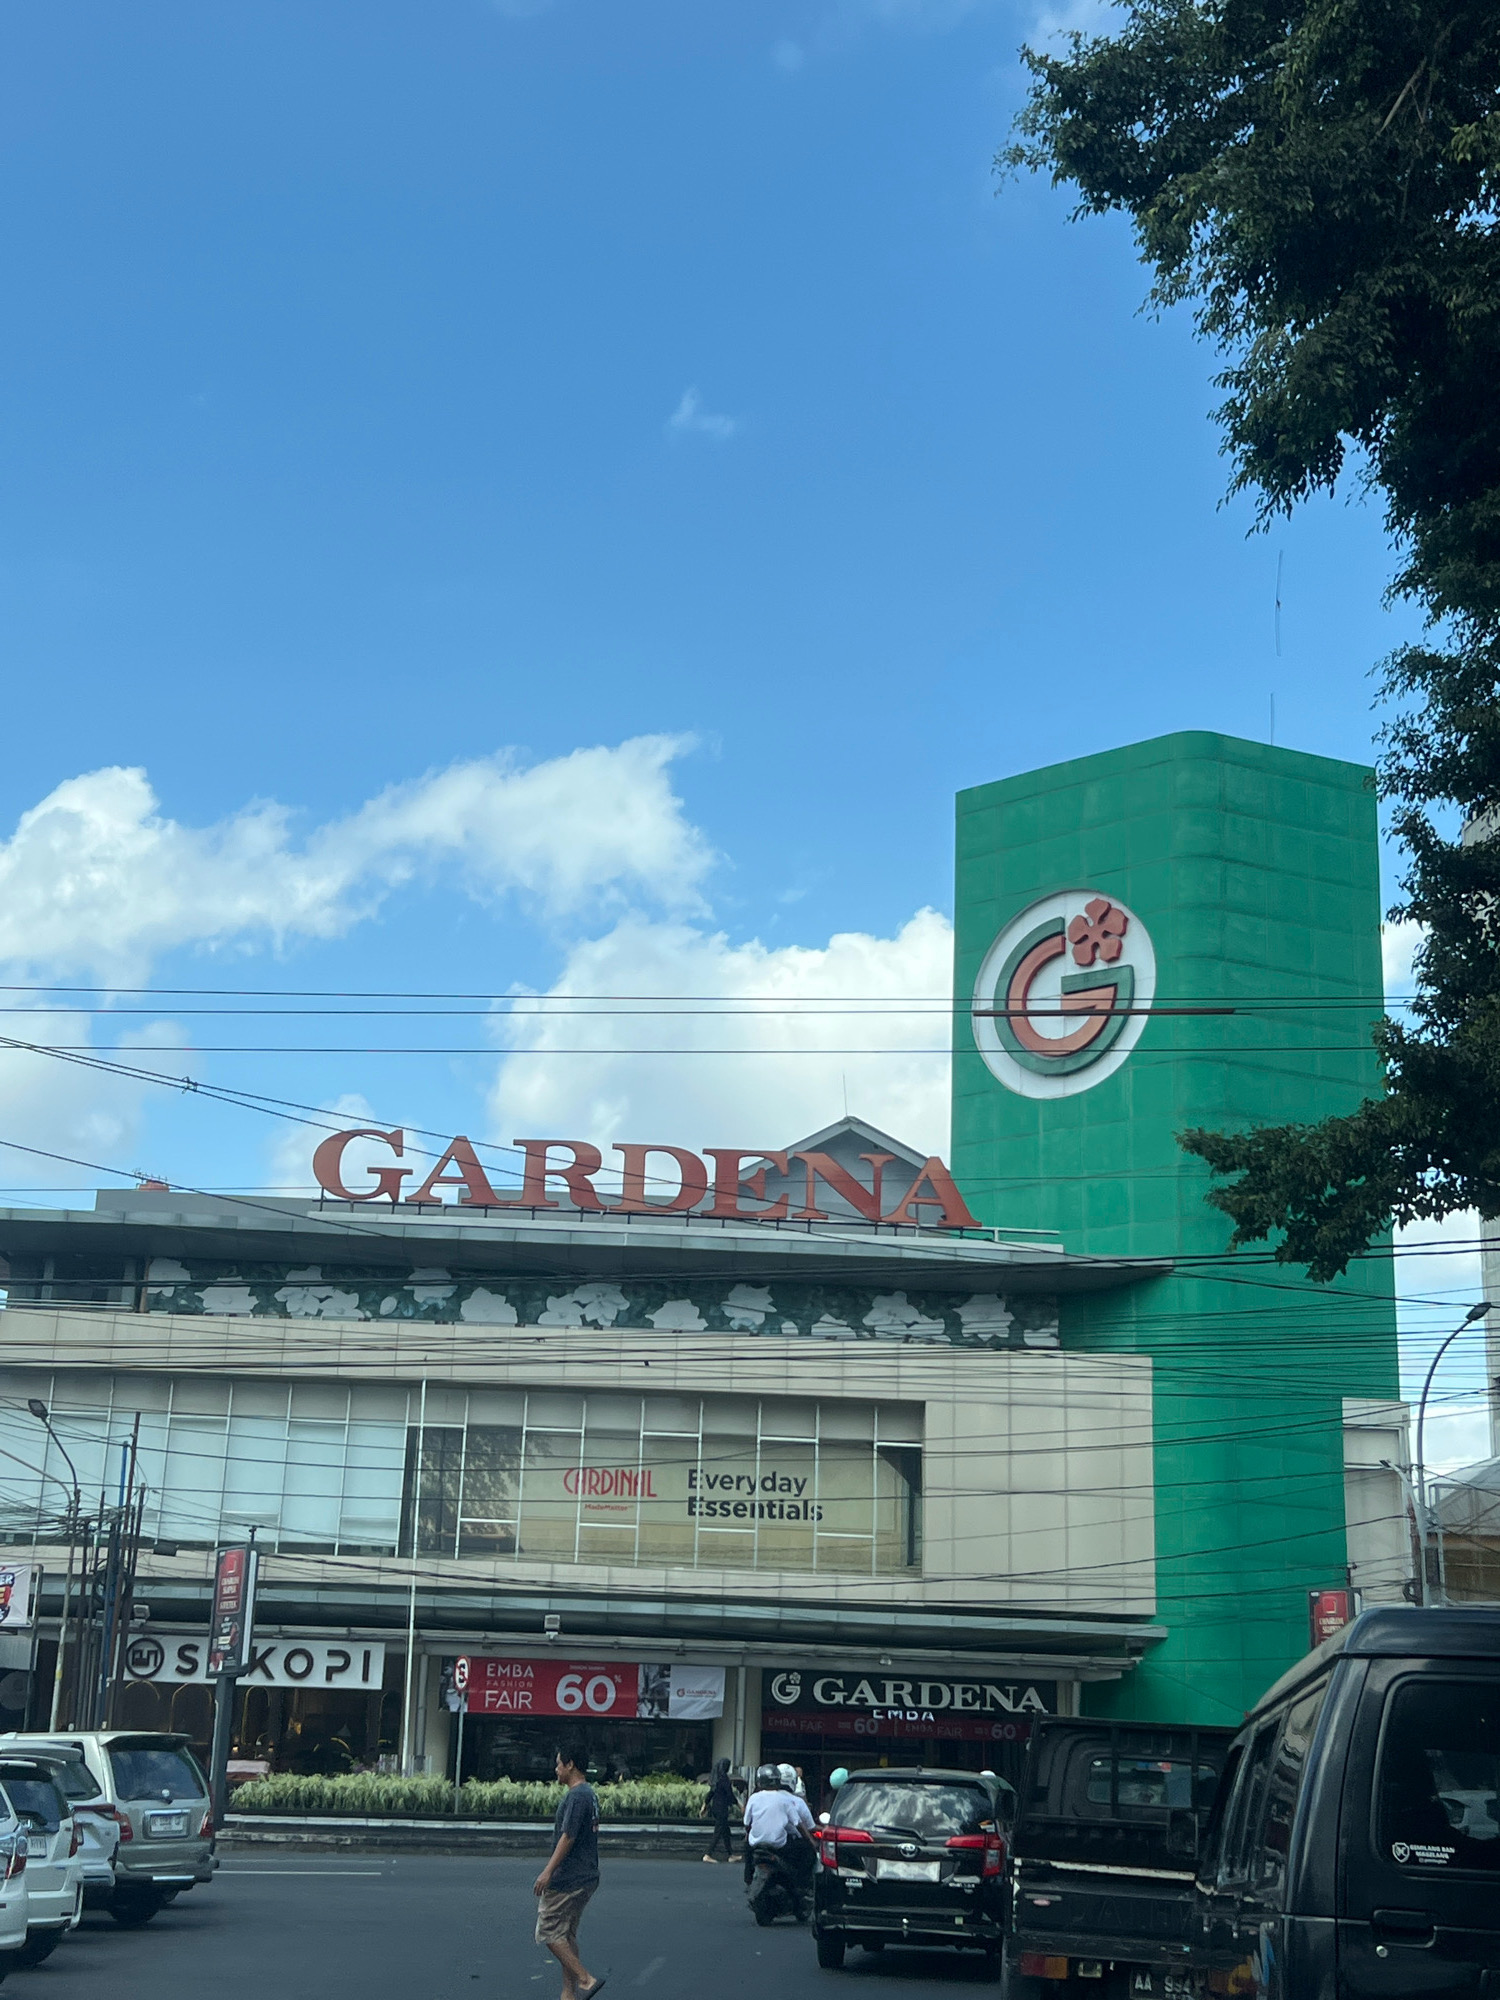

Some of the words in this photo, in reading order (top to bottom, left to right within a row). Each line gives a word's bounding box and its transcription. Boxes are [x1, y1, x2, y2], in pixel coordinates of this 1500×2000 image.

[312, 1128, 982, 1228] GARDENA
[563, 1468, 658, 1498] CARDINAL
[687, 1468, 808, 1498] Everyday
[687, 1495, 823, 1522] Essentials
[486, 1663, 535, 1678] EMBA
[486, 1680, 533, 1689] FASHION
[484, 1690, 533, 1710] FAIR
[812, 1677, 1049, 1714] GARDENA
